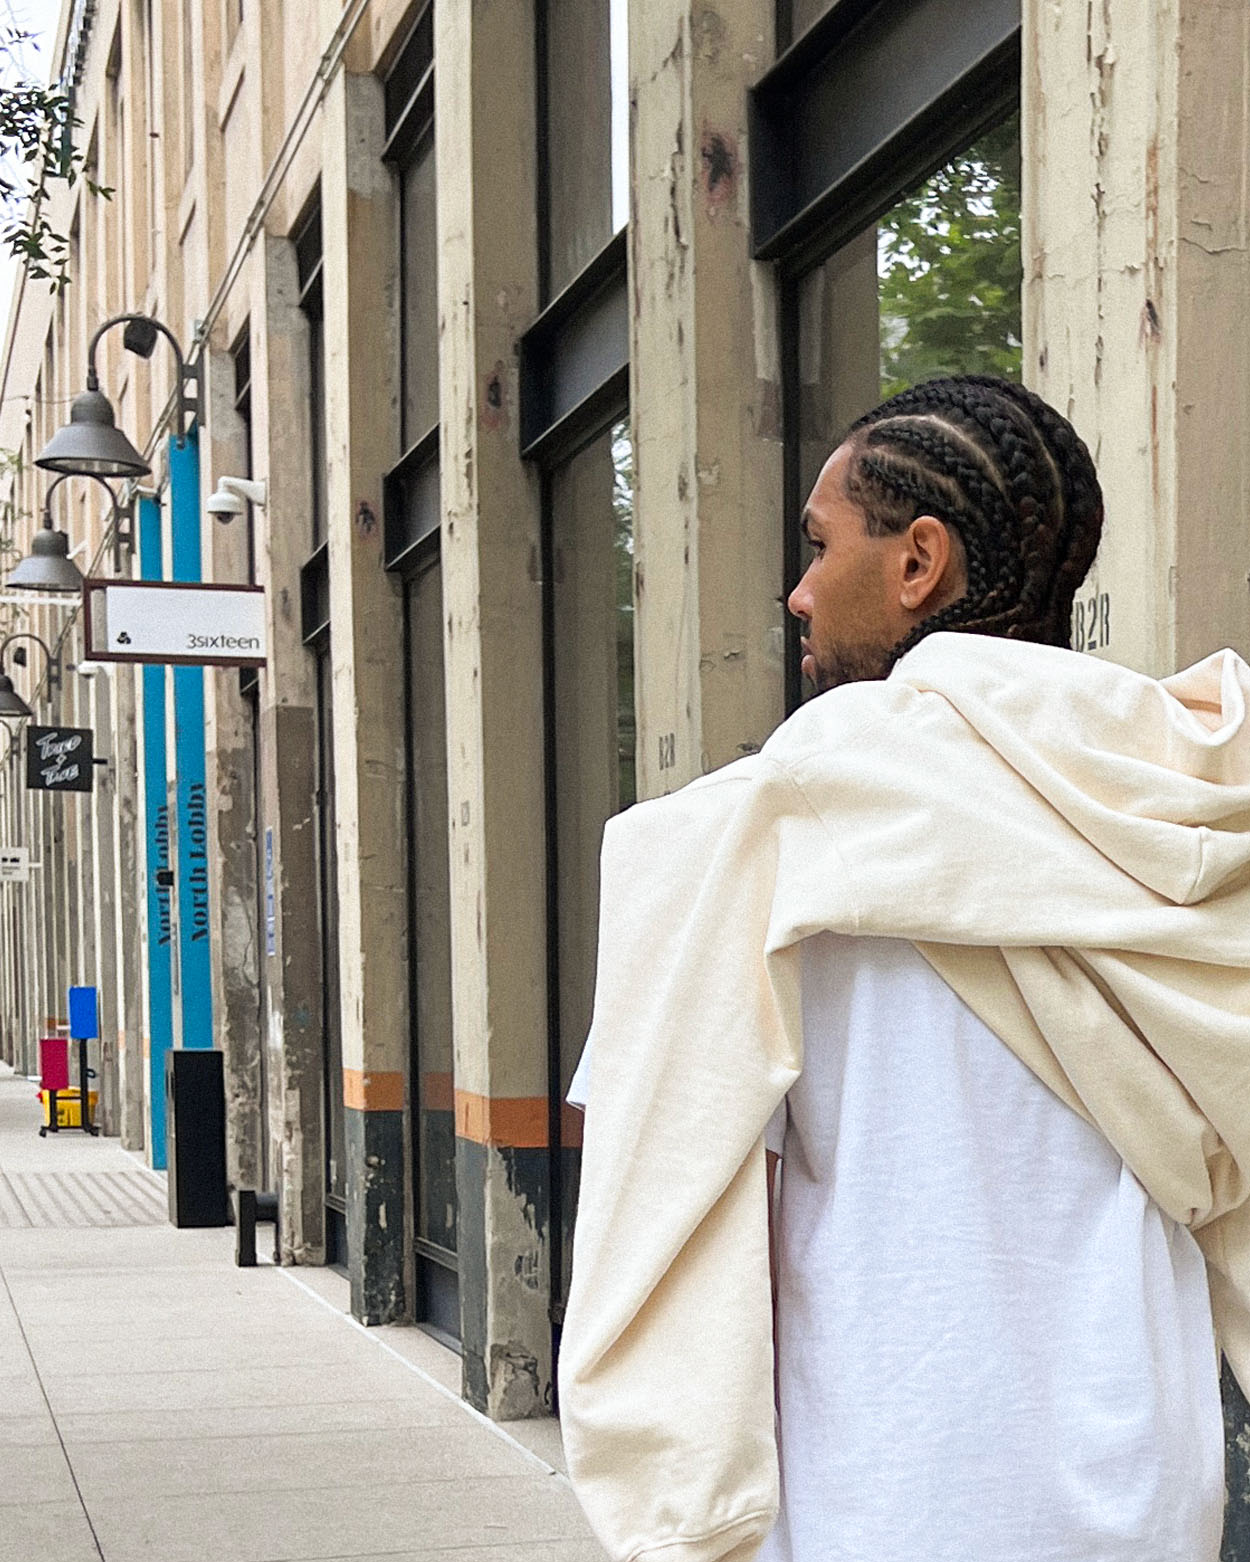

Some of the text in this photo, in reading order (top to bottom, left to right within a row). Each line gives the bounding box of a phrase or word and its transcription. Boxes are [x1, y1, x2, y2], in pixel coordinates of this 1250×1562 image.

[186, 633, 260, 649] 3sixteen
[187, 783, 208, 941] North Lobby
